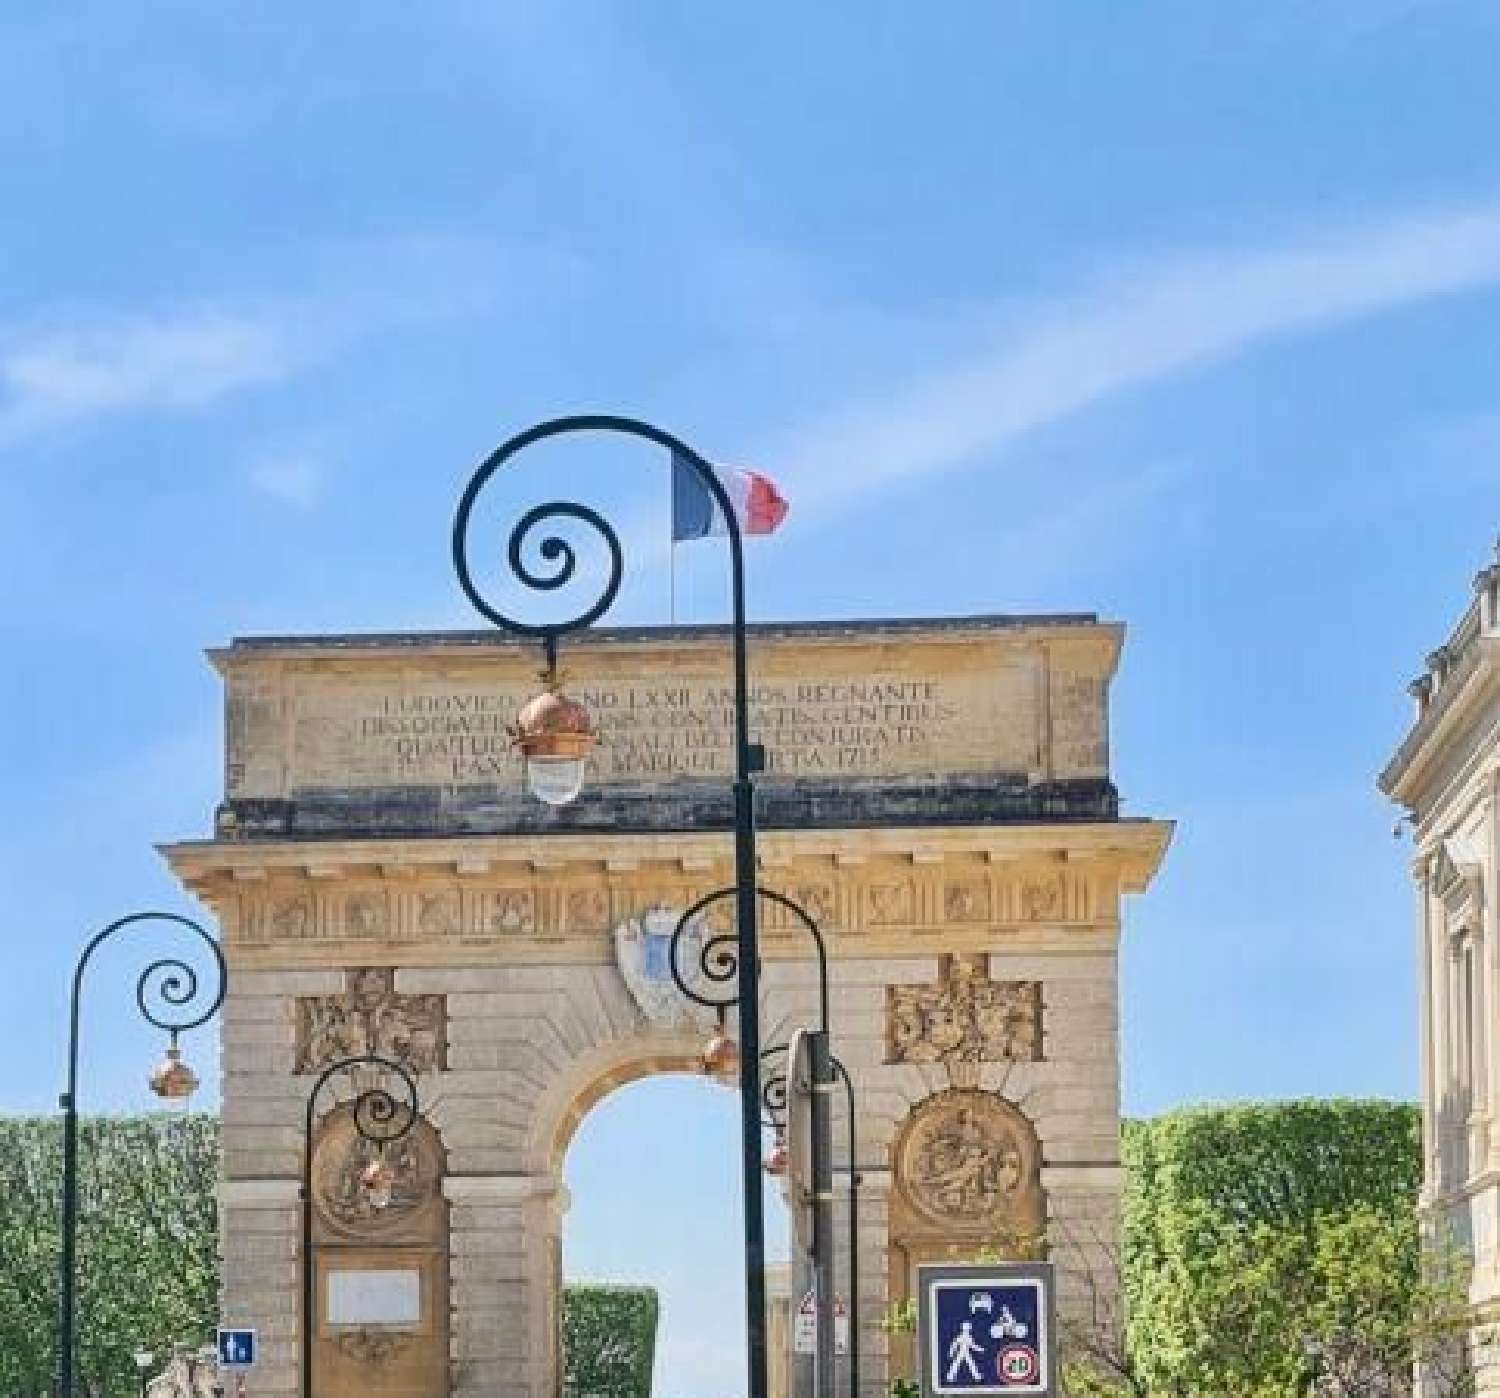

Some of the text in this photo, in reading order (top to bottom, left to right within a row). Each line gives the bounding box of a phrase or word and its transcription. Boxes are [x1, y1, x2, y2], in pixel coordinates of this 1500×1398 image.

[797, 682, 935, 703] REGNANTE
[648, 704, 817, 729] CONCILATIS
[1007, 1356, 1029, 1373] 20
